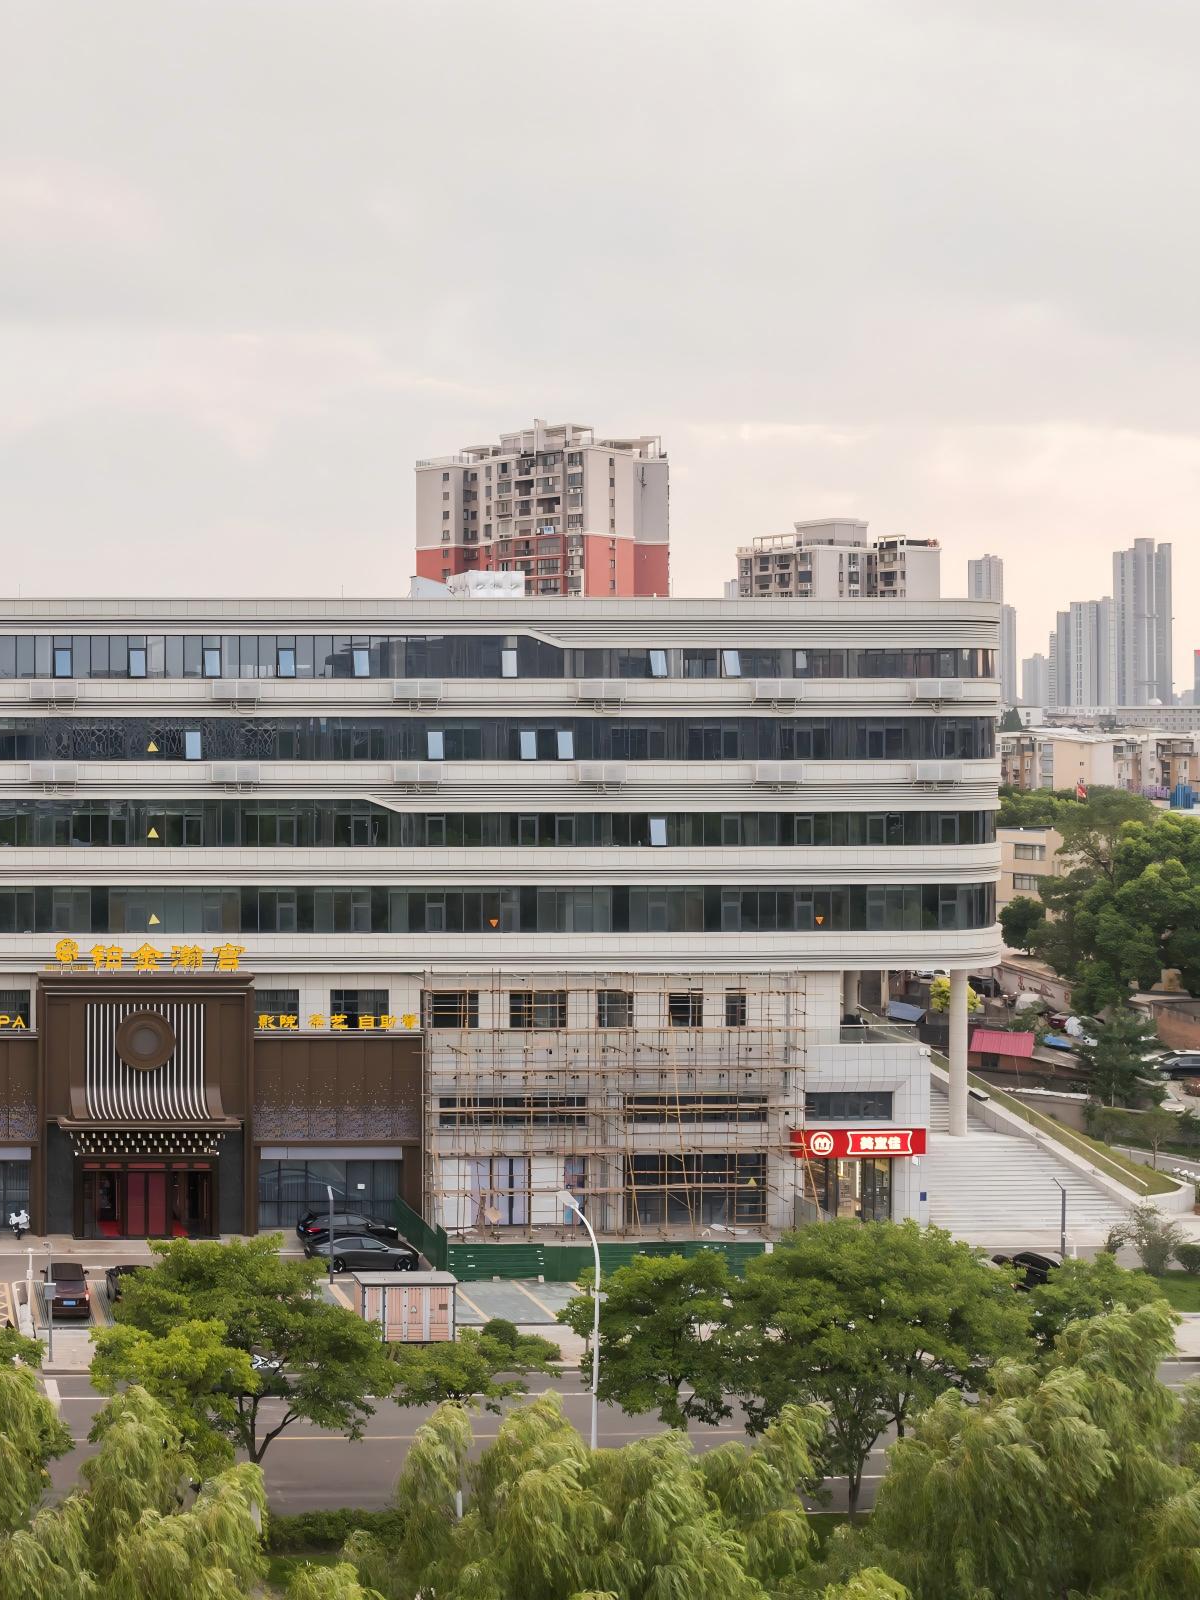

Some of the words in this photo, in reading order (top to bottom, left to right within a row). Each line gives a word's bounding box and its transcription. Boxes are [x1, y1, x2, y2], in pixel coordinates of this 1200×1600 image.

[258, 1014, 298, 1029] 影院
[308, 1013, 348, 1029] 茶艺
[358, 1014, 418, 1029] 自助餐
[860, 1136, 901, 1150] 美宜佳
